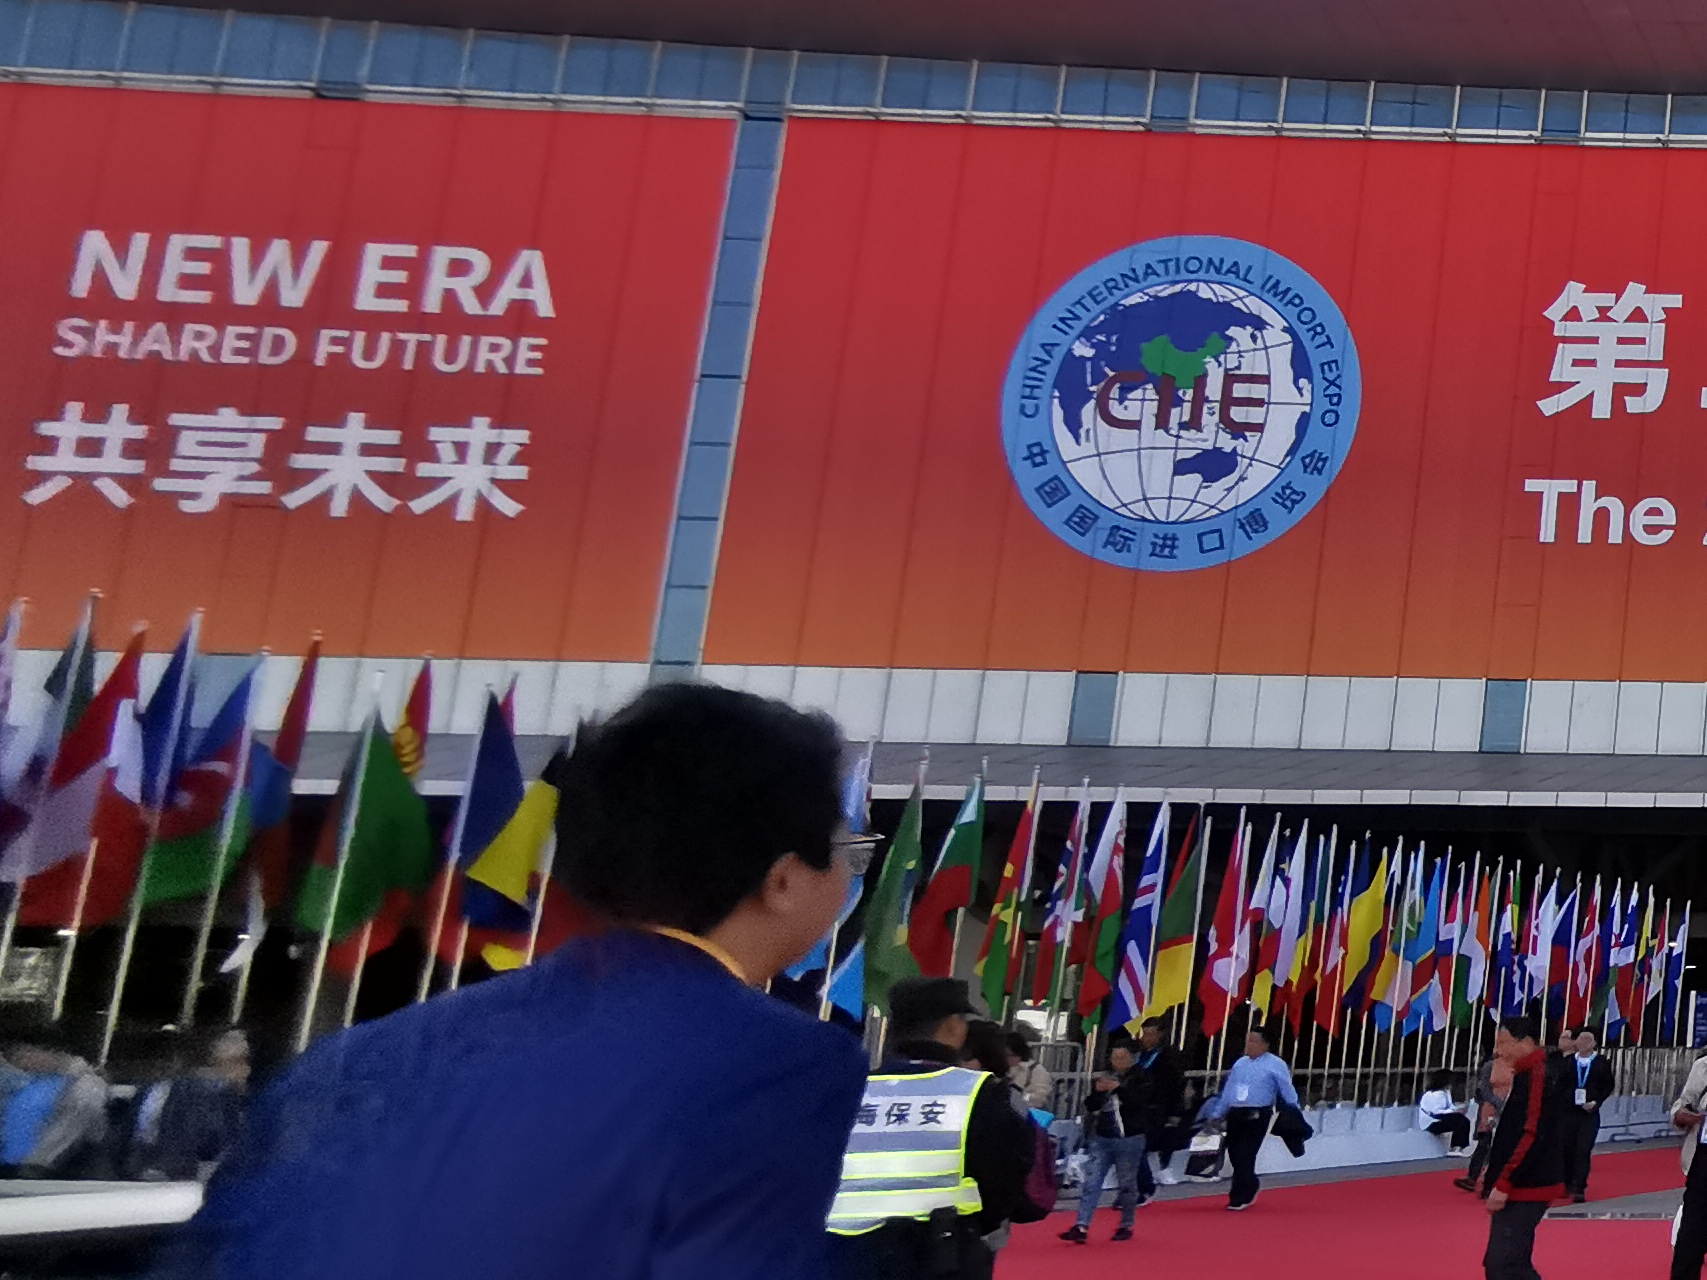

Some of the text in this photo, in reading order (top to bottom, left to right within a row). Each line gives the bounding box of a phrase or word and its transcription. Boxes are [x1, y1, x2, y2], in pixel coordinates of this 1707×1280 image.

[69, 229, 556, 318] NEW ERA
[52, 317, 549, 375] SHARED FUTURE
[1020, 255, 1342, 428] CHINA INTERNATIONAL IMPORT EXPO
[1096, 371, 1270, 433] CIIE
[22, 401, 531, 521] 共享未来
[1022, 441, 1329, 560] 中国国际进口博览会
[1524, 478, 1677, 546] The
